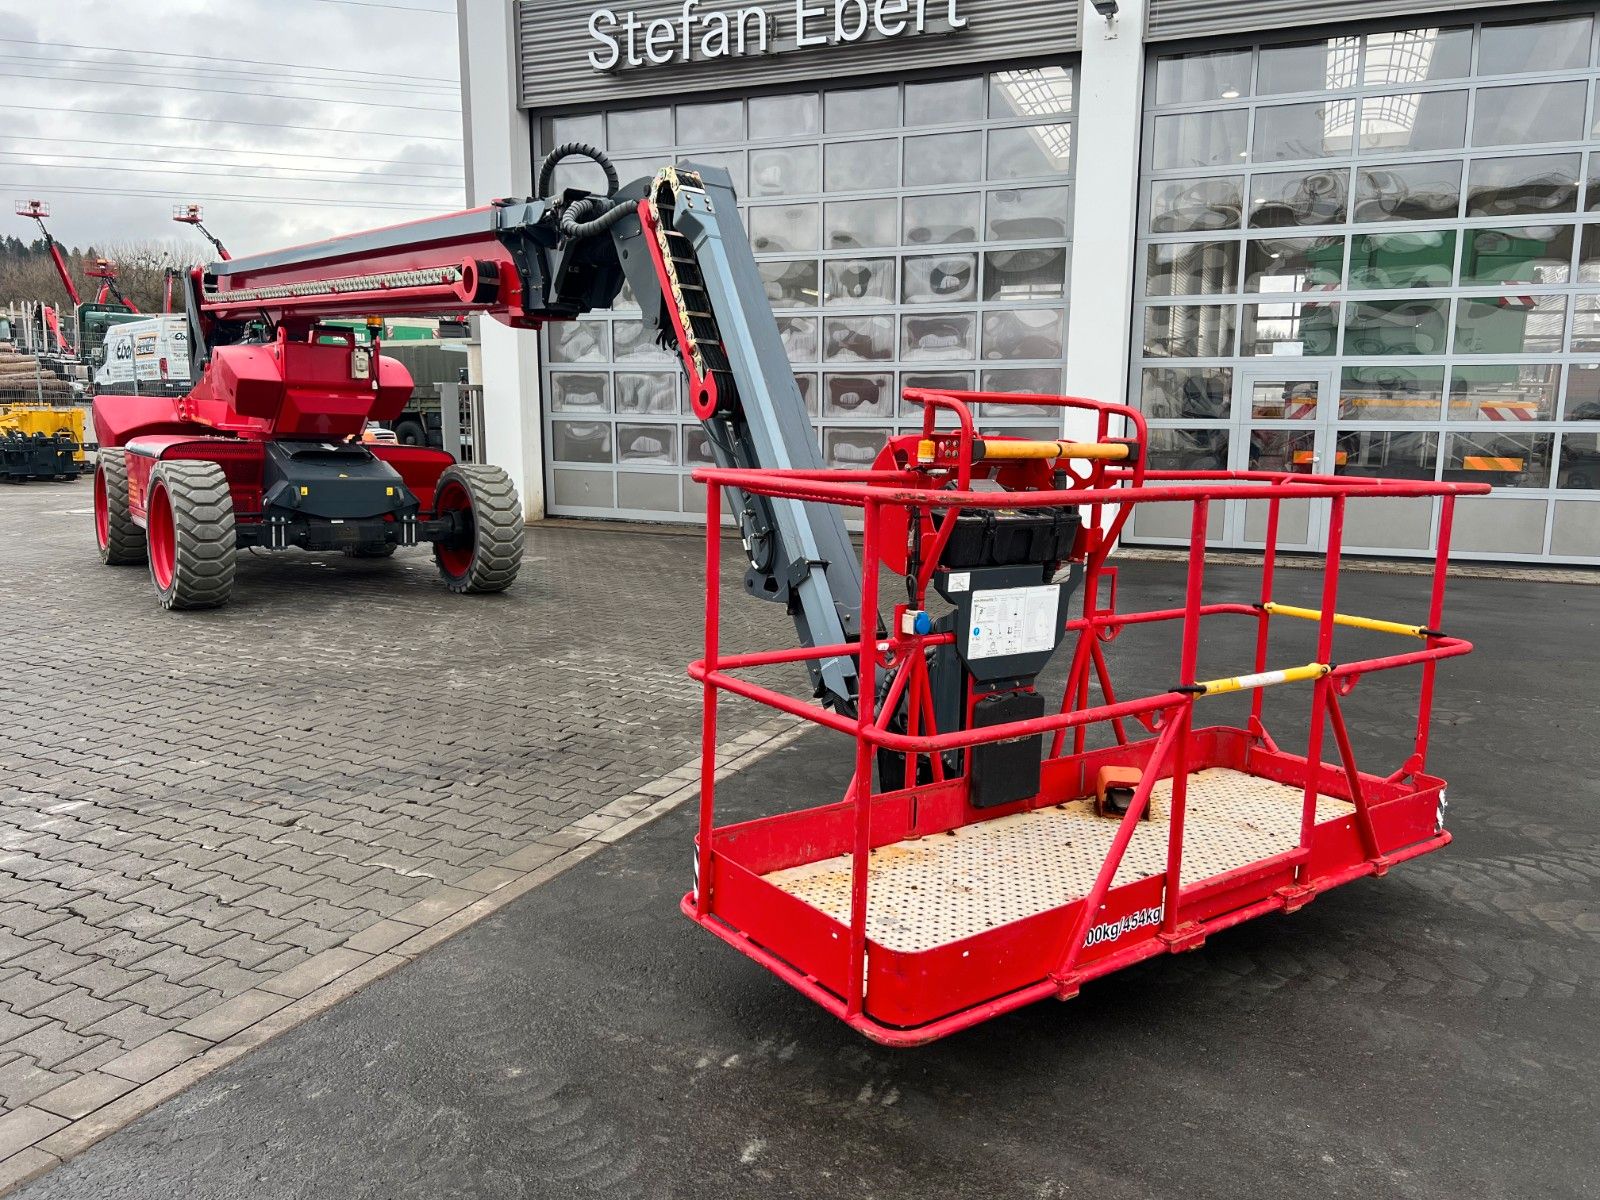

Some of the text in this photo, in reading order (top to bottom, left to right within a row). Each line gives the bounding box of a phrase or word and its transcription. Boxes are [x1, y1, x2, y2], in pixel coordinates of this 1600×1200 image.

[588, 0, 967, 70] Stefan Ebert
[1085, 907, 1161, 946] 00kg/454kg
